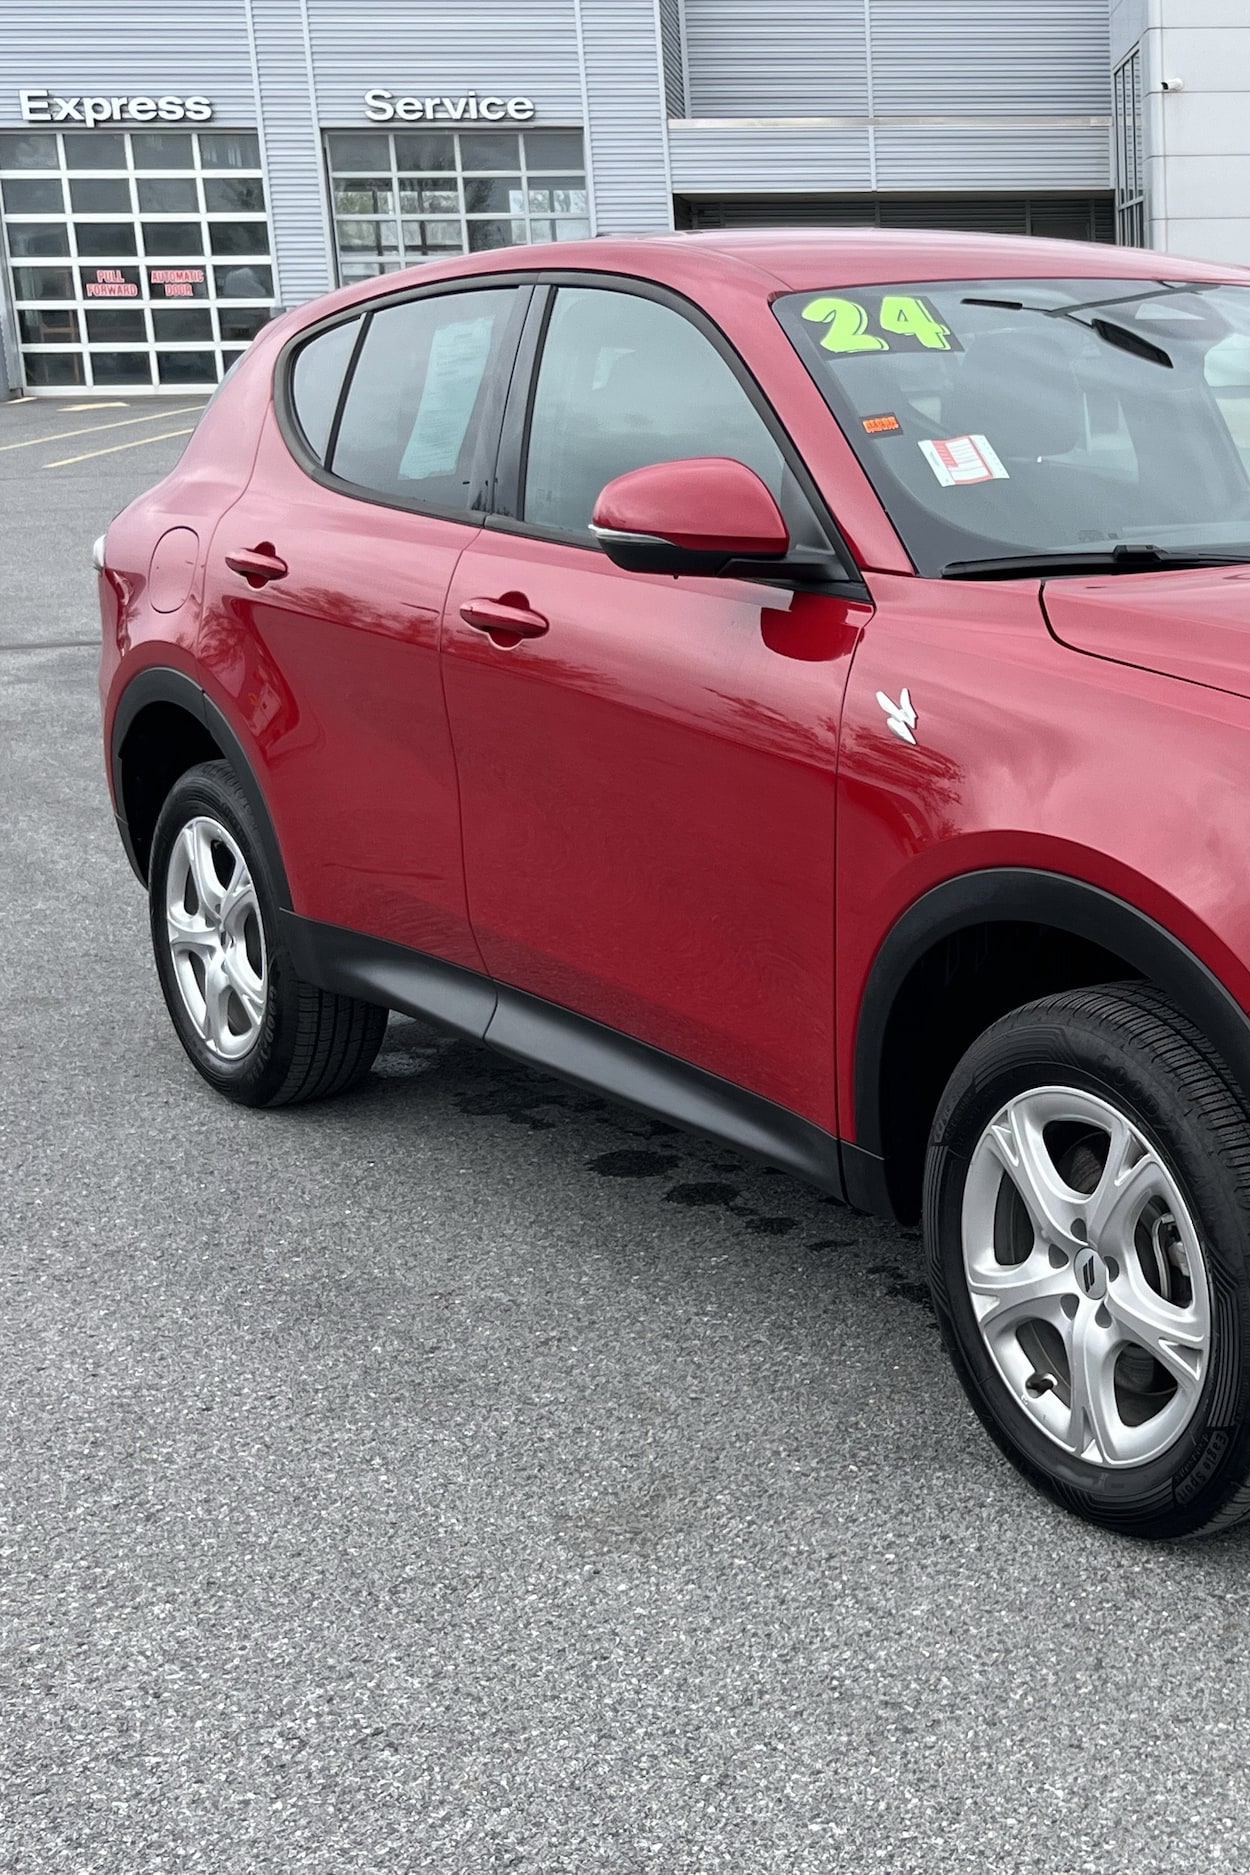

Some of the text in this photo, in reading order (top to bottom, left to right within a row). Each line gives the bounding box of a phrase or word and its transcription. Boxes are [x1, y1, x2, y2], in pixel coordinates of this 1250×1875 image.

[19, 89, 213, 128] Express
[364, 89, 536, 121] Service
[86, 283, 138, 297] FORWARD
[96, 270, 125, 283] PULL
[151, 270, 204, 283] AUTOMATIC
[165, 283, 193, 297] DOOR
[801, 296, 952, 353] 24
[1202, 1433, 1227, 1470] Eagle
[1176, 1471, 1207, 1501] Sport
